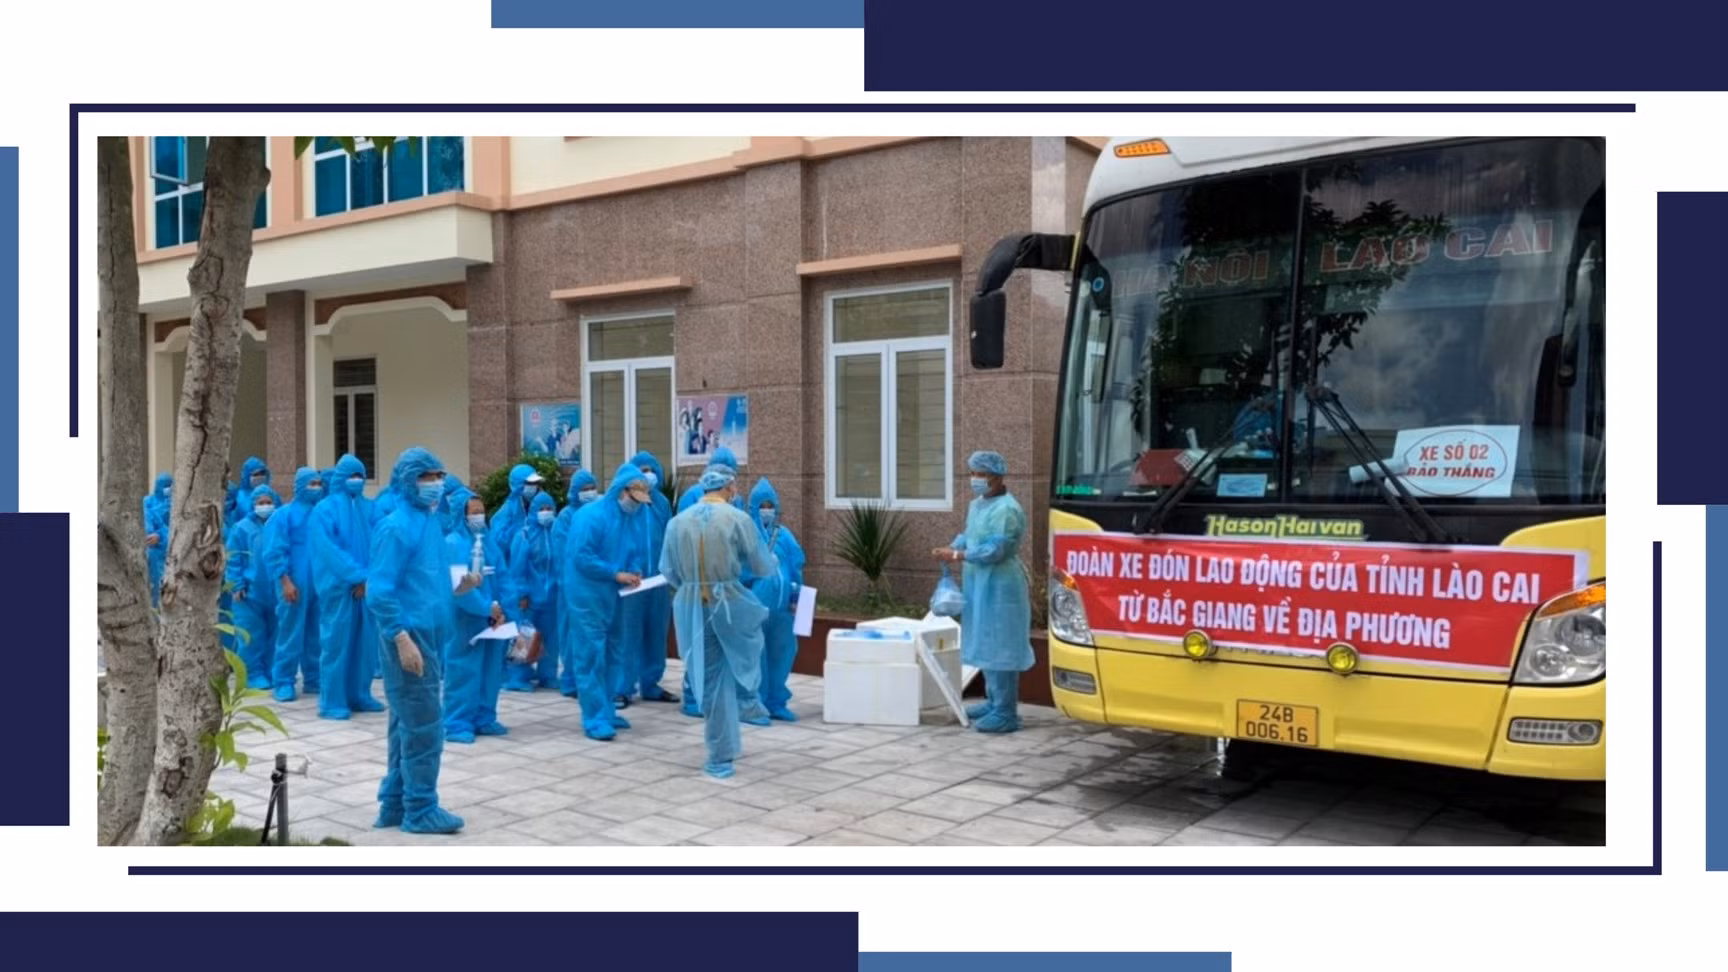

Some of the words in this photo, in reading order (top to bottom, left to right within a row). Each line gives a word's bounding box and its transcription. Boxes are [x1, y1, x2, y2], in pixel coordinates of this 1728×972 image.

[1444, 219, 1554, 261] CAI
[1419, 445, 1439, 461] XE
[1443, 438, 1466, 461] SỐ
[1469, 444, 1489, 460] 02
[1067, 546, 1114, 577] ĐOÀN
[1119, 551, 1143, 579] XE
[1149, 549, 1190, 582] ĐÓN
[1196, 556, 1234, 584] LAO
[1240, 553, 1302, 592] ĐỘNG
[1310, 551, 1358, 592] CỦA
[1366, 554, 1424, 597] TỈNH
[1432, 563, 1483, 600] LÀO
[1492, 571, 1540, 604] CAI
[1118, 589, 1144, 622] TỪ
[1147, 589, 1186, 625] BẮC
[1193, 600, 1256, 631] GIANG
[1263, 596, 1292, 634] VỀ
[1297, 608, 1338, 644] ĐỊA
[1345, 611, 1450, 649] PHƯƠNG
[1260, 704, 1293, 723] 24B
[1246, 721, 1308, 743] 006.16
